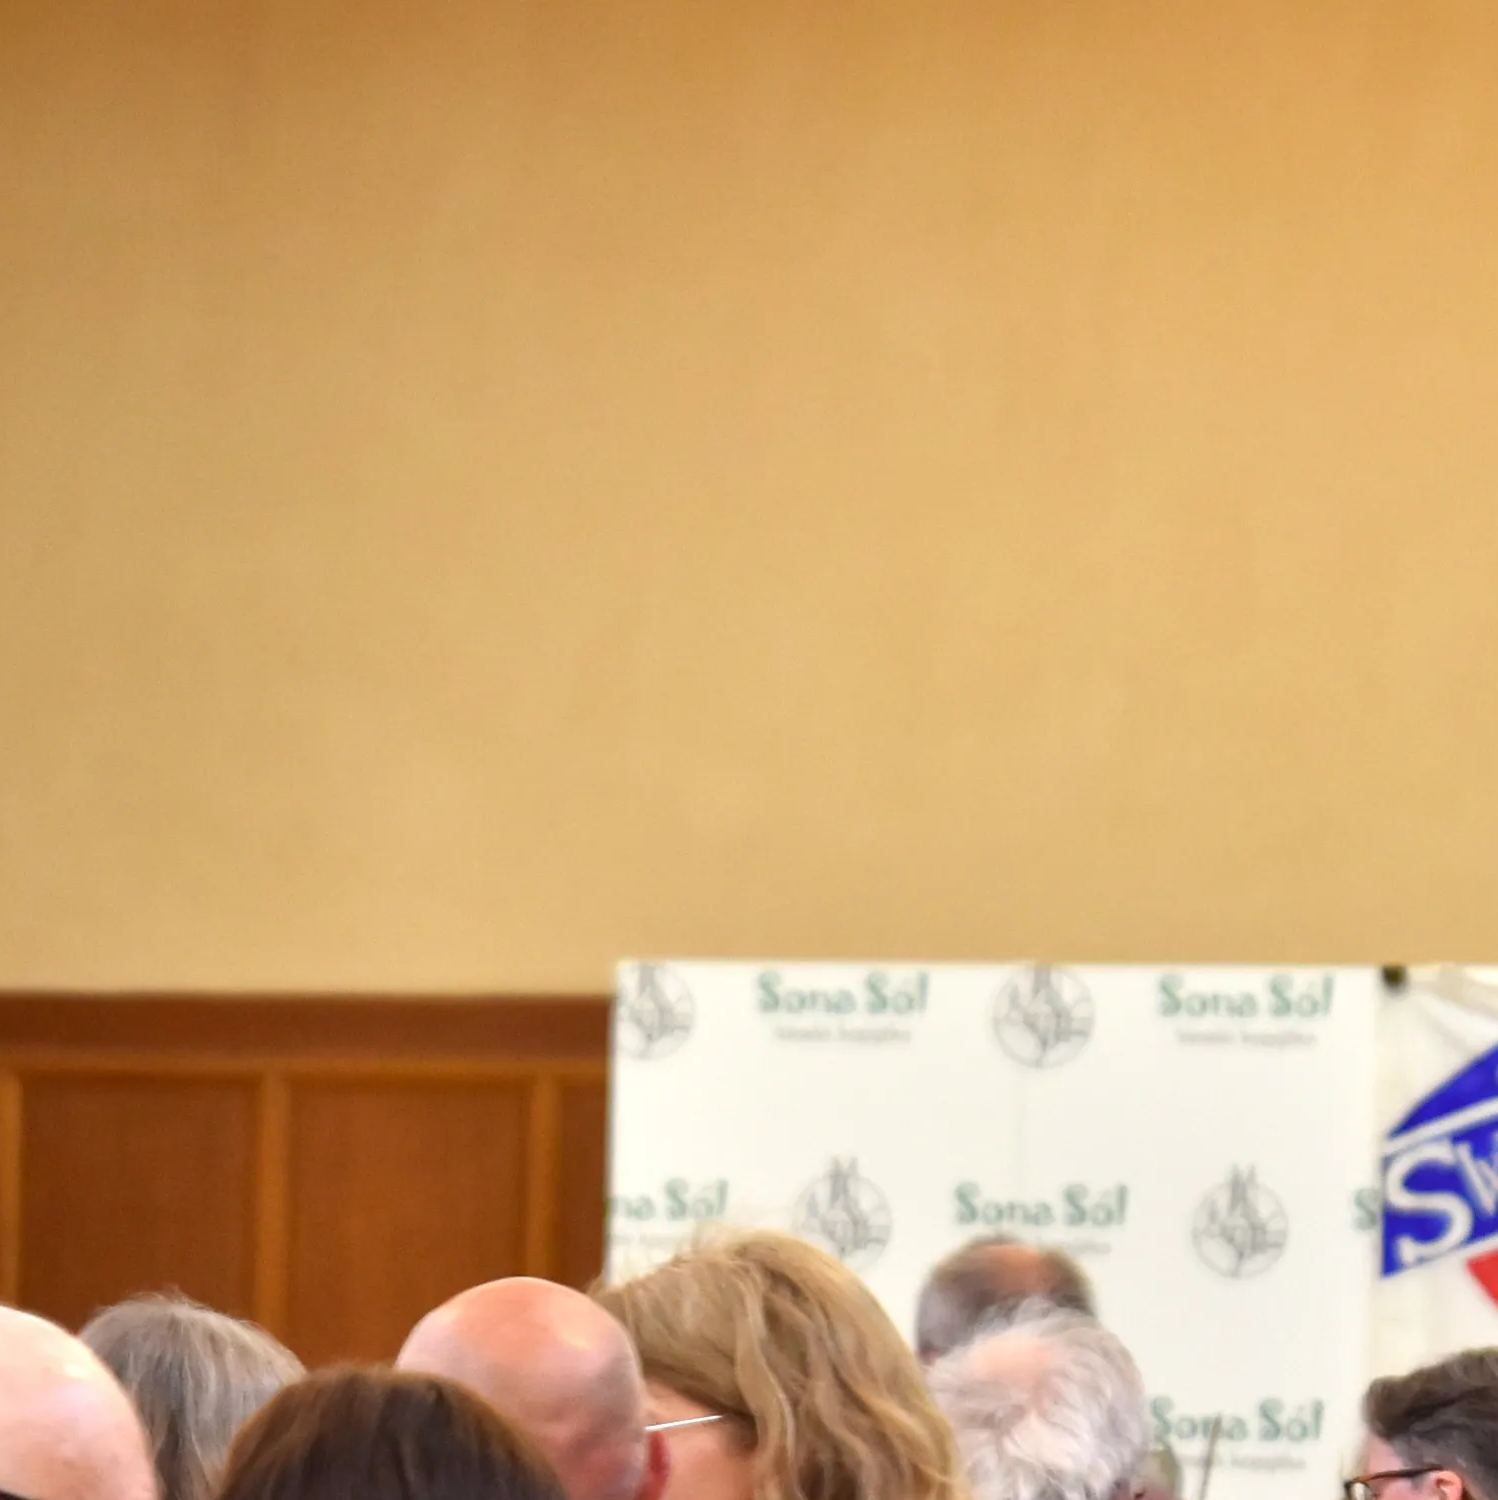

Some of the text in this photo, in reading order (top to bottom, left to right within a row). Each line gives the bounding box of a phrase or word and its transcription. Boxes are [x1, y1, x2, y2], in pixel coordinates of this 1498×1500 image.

[757, 972, 858, 1015] Sona
[1159, 974, 1259, 1018] Sona
[953, 1180, 1055, 1227] Sona
